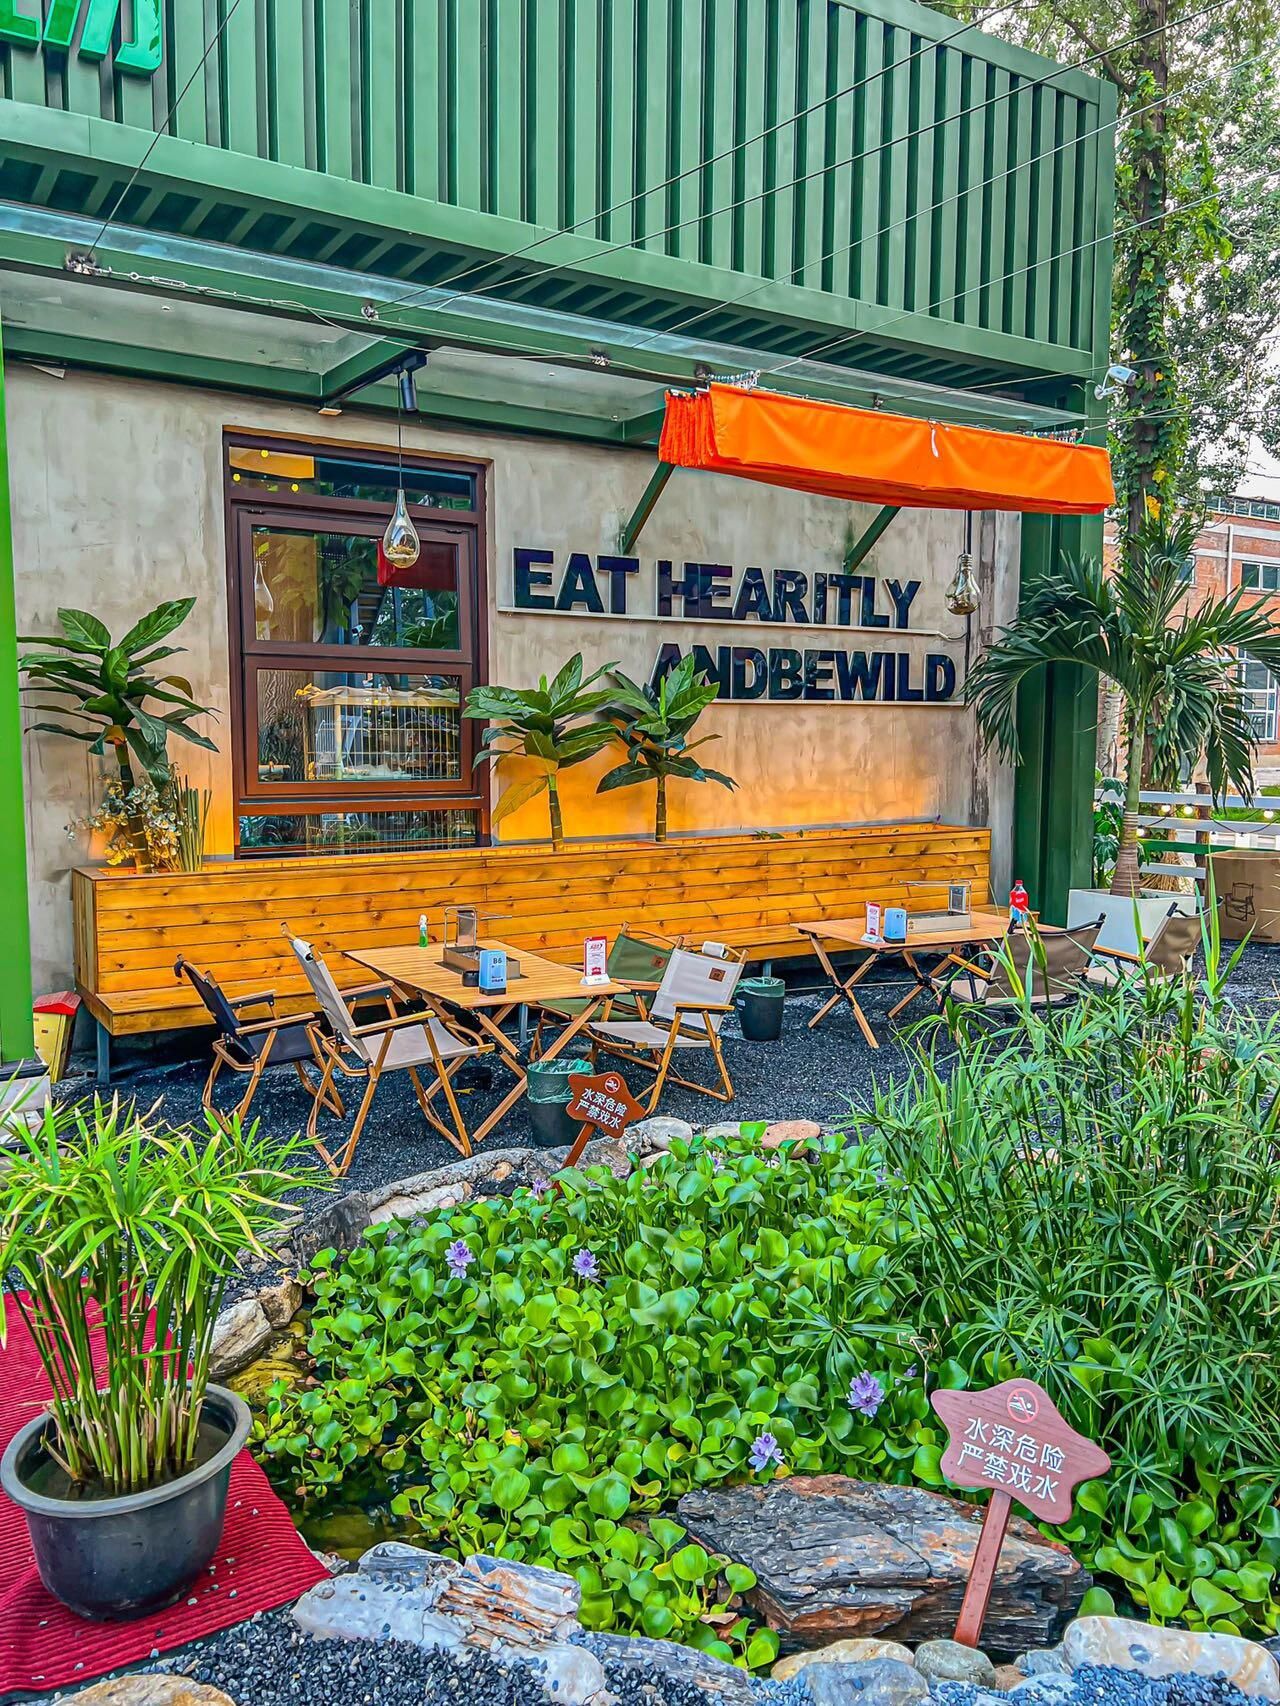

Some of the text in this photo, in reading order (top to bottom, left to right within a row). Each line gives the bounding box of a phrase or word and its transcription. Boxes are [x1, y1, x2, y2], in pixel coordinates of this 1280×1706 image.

[513, 547, 921, 628] EAT HEARITLY
[575, 1099, 621, 1129] 严禁戏水
[582, 1088, 627, 1116] 水深危险
[957, 1442, 1059, 1503] 严禁戏水
[964, 1417, 1066, 1474] 水深危险
